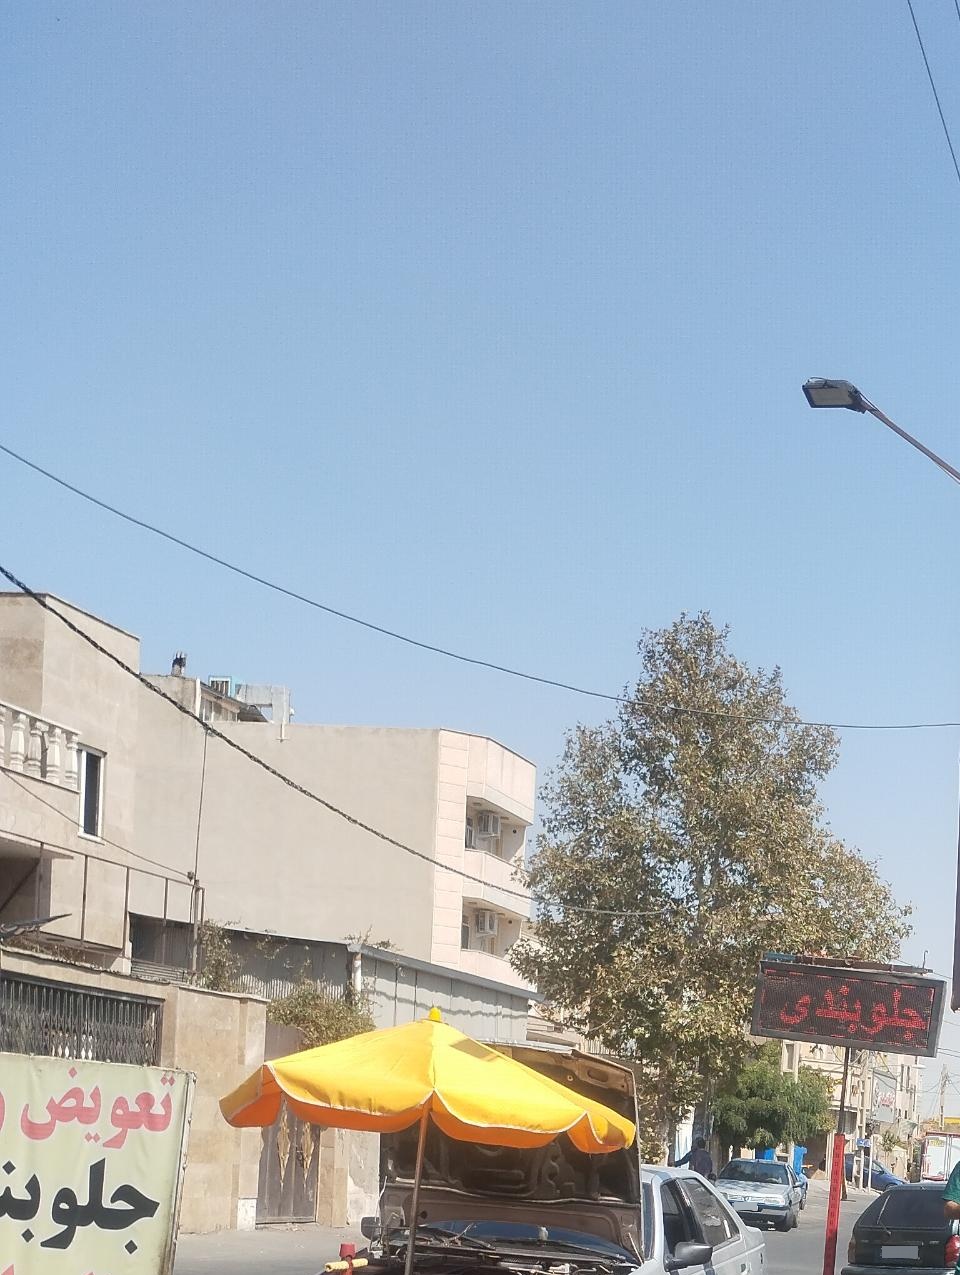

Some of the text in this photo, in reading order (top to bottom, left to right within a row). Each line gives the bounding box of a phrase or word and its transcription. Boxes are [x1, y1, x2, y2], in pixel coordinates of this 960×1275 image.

[779, 984, 928, 1041] جلوبندی
[20, 1066, 176, 1149] تعویض
[0, 1157, 160, 1254] جلوبن
